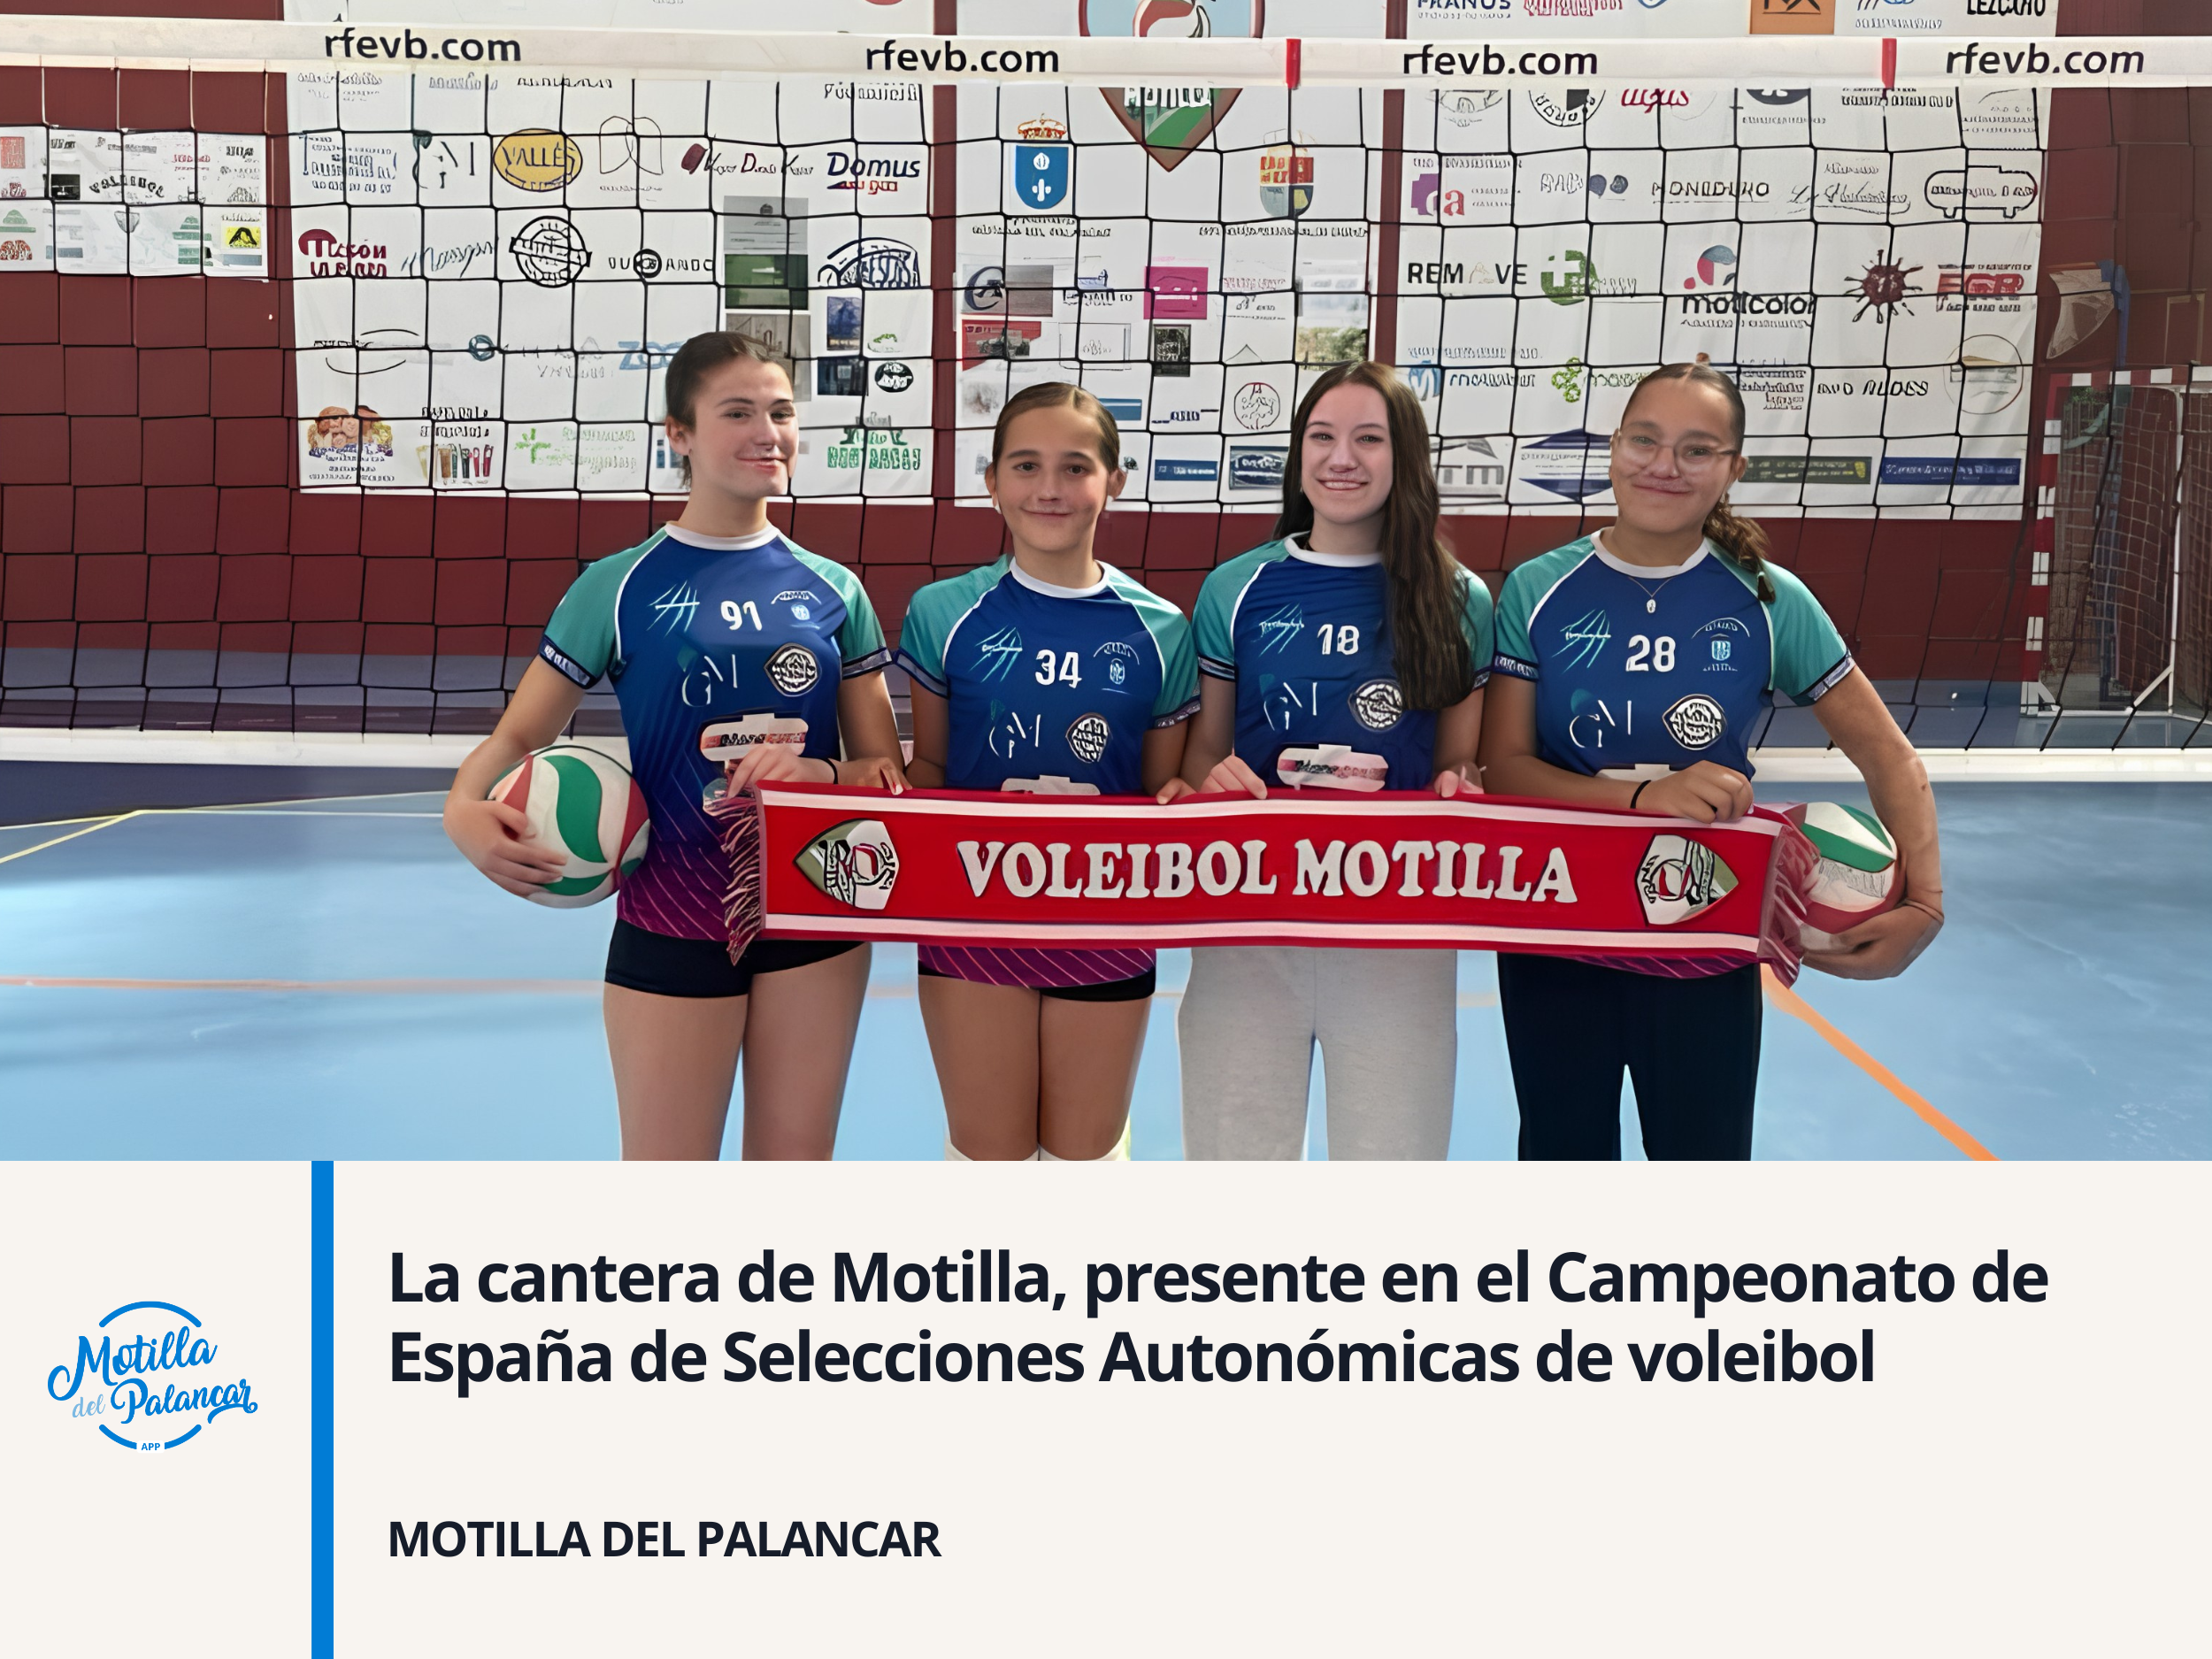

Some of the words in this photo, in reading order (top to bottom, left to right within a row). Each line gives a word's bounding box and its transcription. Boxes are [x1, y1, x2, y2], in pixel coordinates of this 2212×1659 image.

[326, 27, 520, 61] rfevb.com
[867, 41, 1058, 73] rfevb.com
[1404, 44, 1597, 74] rfevb.com
[1947, 42, 2144, 74] rfevb.com
[827, 151, 920, 177] Domus
[720, 601, 763, 631] 91
[1317, 624, 1360, 656] 18
[1625, 634, 1676, 672] 28
[1035, 649, 1082, 688] 34
[957, 840, 1278, 899] VOLEIBOL
[1293, 839, 1578, 903] MOTILLA
